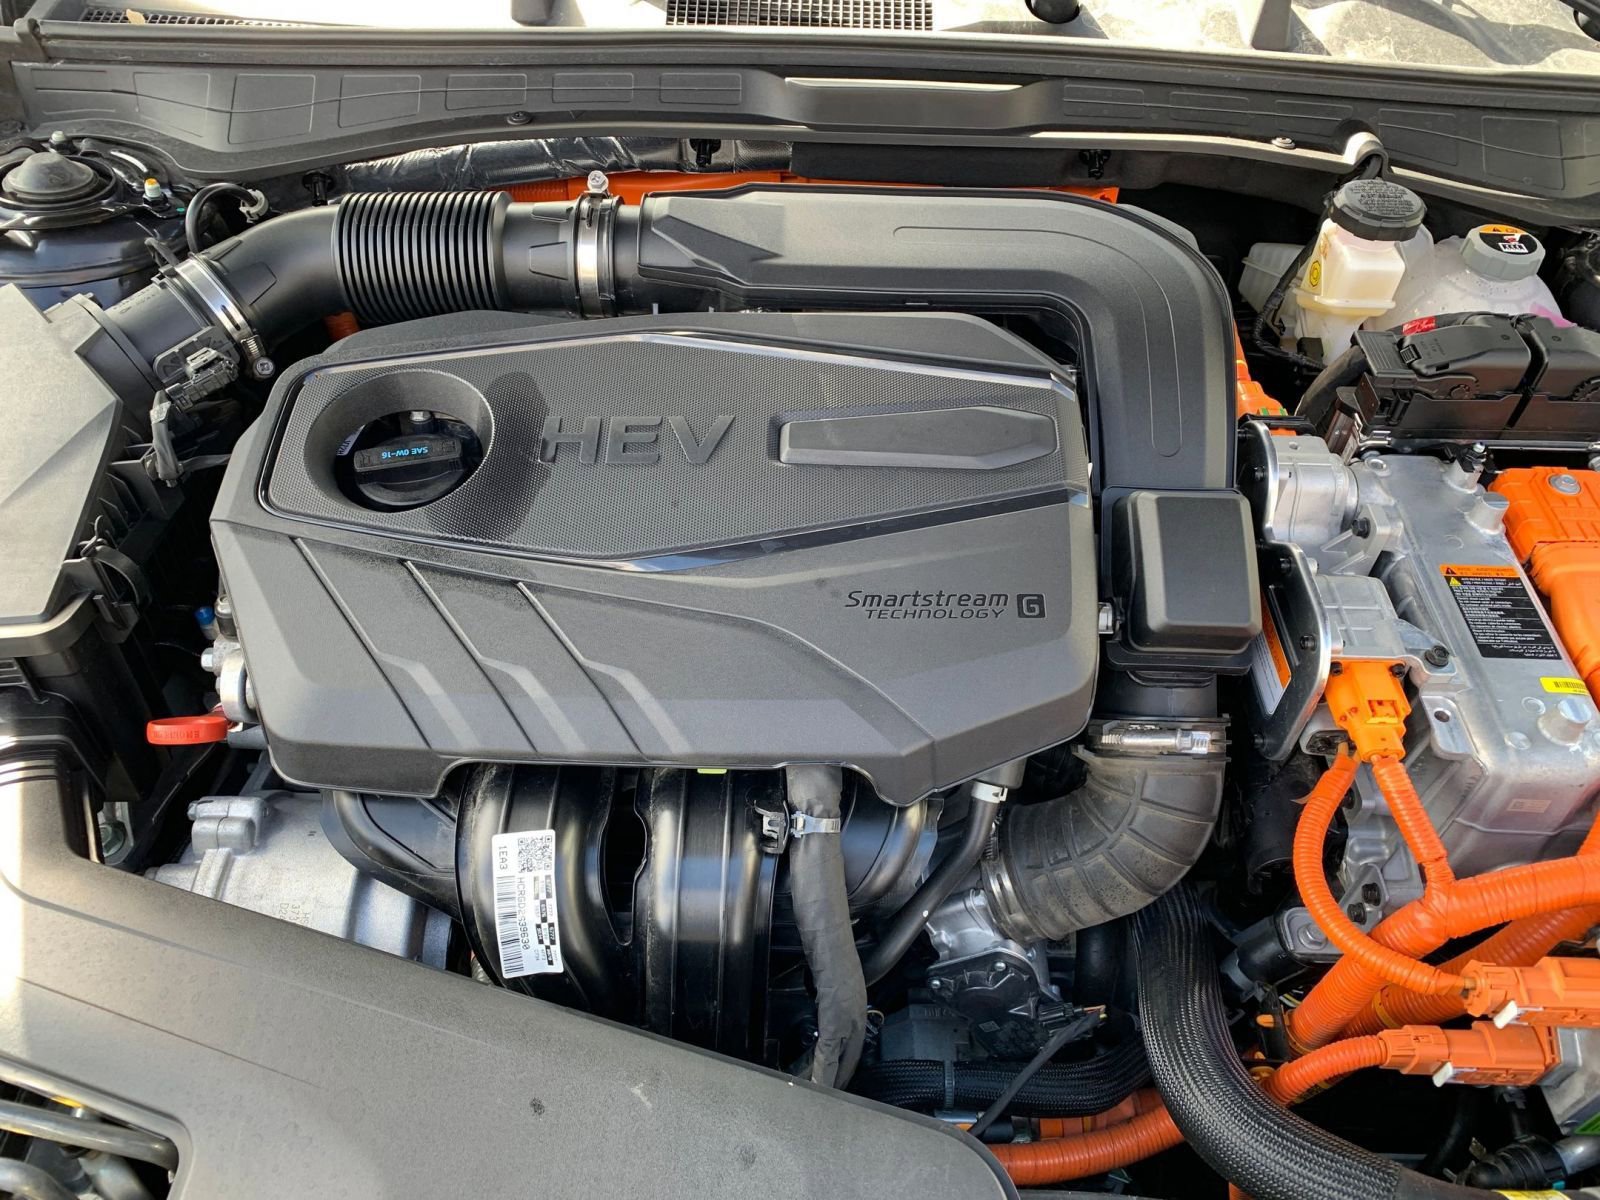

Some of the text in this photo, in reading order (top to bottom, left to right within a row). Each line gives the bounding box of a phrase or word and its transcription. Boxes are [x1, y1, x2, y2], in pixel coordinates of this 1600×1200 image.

[538, 415, 736, 464] HEV
[381, 446, 429, 459] SAE 0W-16
[845, 590, 1009, 608] Smartstream
[1019, 594, 1043, 617] G
[865, 608, 1005, 620] TECHNOLOGY
[498, 845, 508, 870] 1EA3
